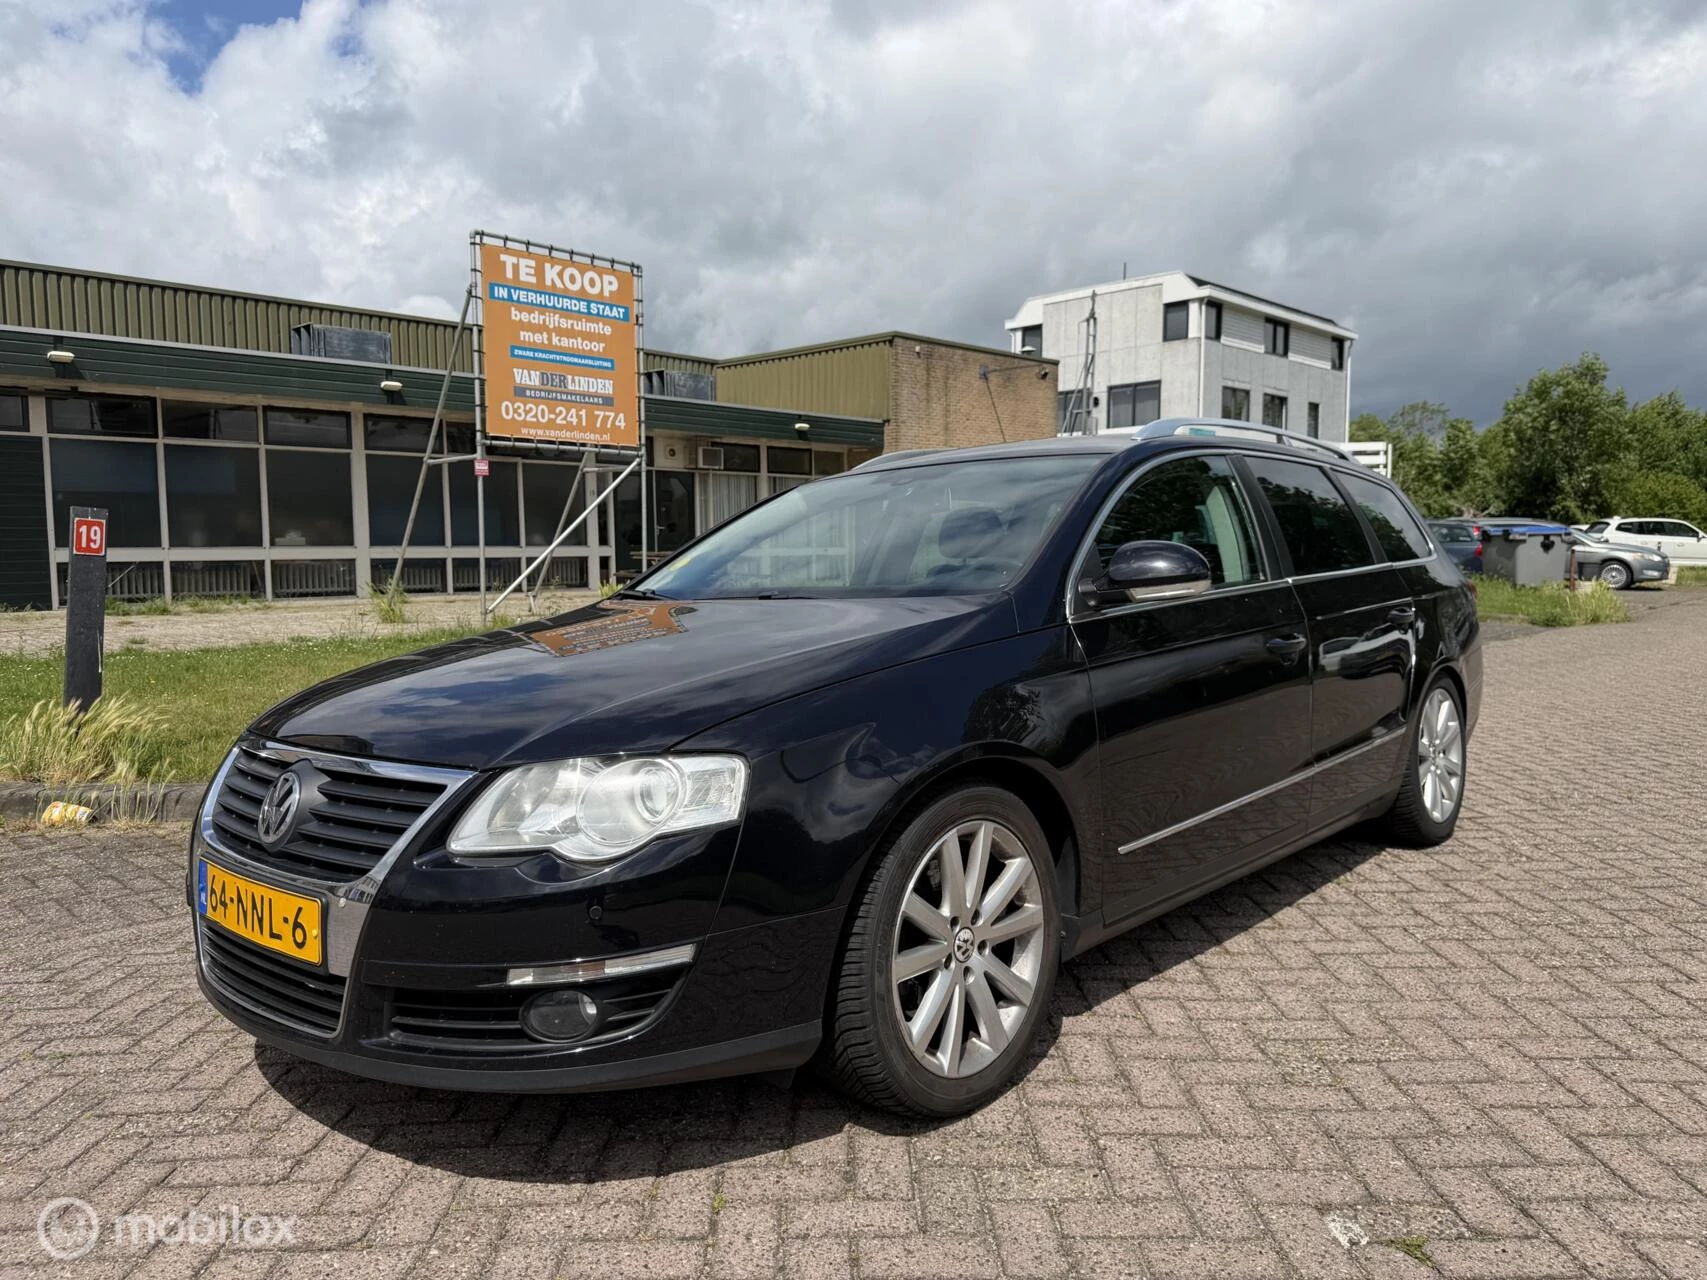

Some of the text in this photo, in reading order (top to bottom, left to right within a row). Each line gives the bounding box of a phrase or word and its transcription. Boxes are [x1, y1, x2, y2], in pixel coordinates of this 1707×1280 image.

[499, 253, 619, 297] TE KOOP
[494, 285, 626, 320] IN VERHUURDE STAAT
[511, 306, 613, 336] bedrijfsruimte
[519, 329, 606, 353] met kantoor
[500, 400, 627, 430] 0320-241 774
[520, 426, 611, 441] www.vanderlinden.nl
[79, 524, 101, 549] 19
[209, 873, 307, 950] 64-NNL-6
